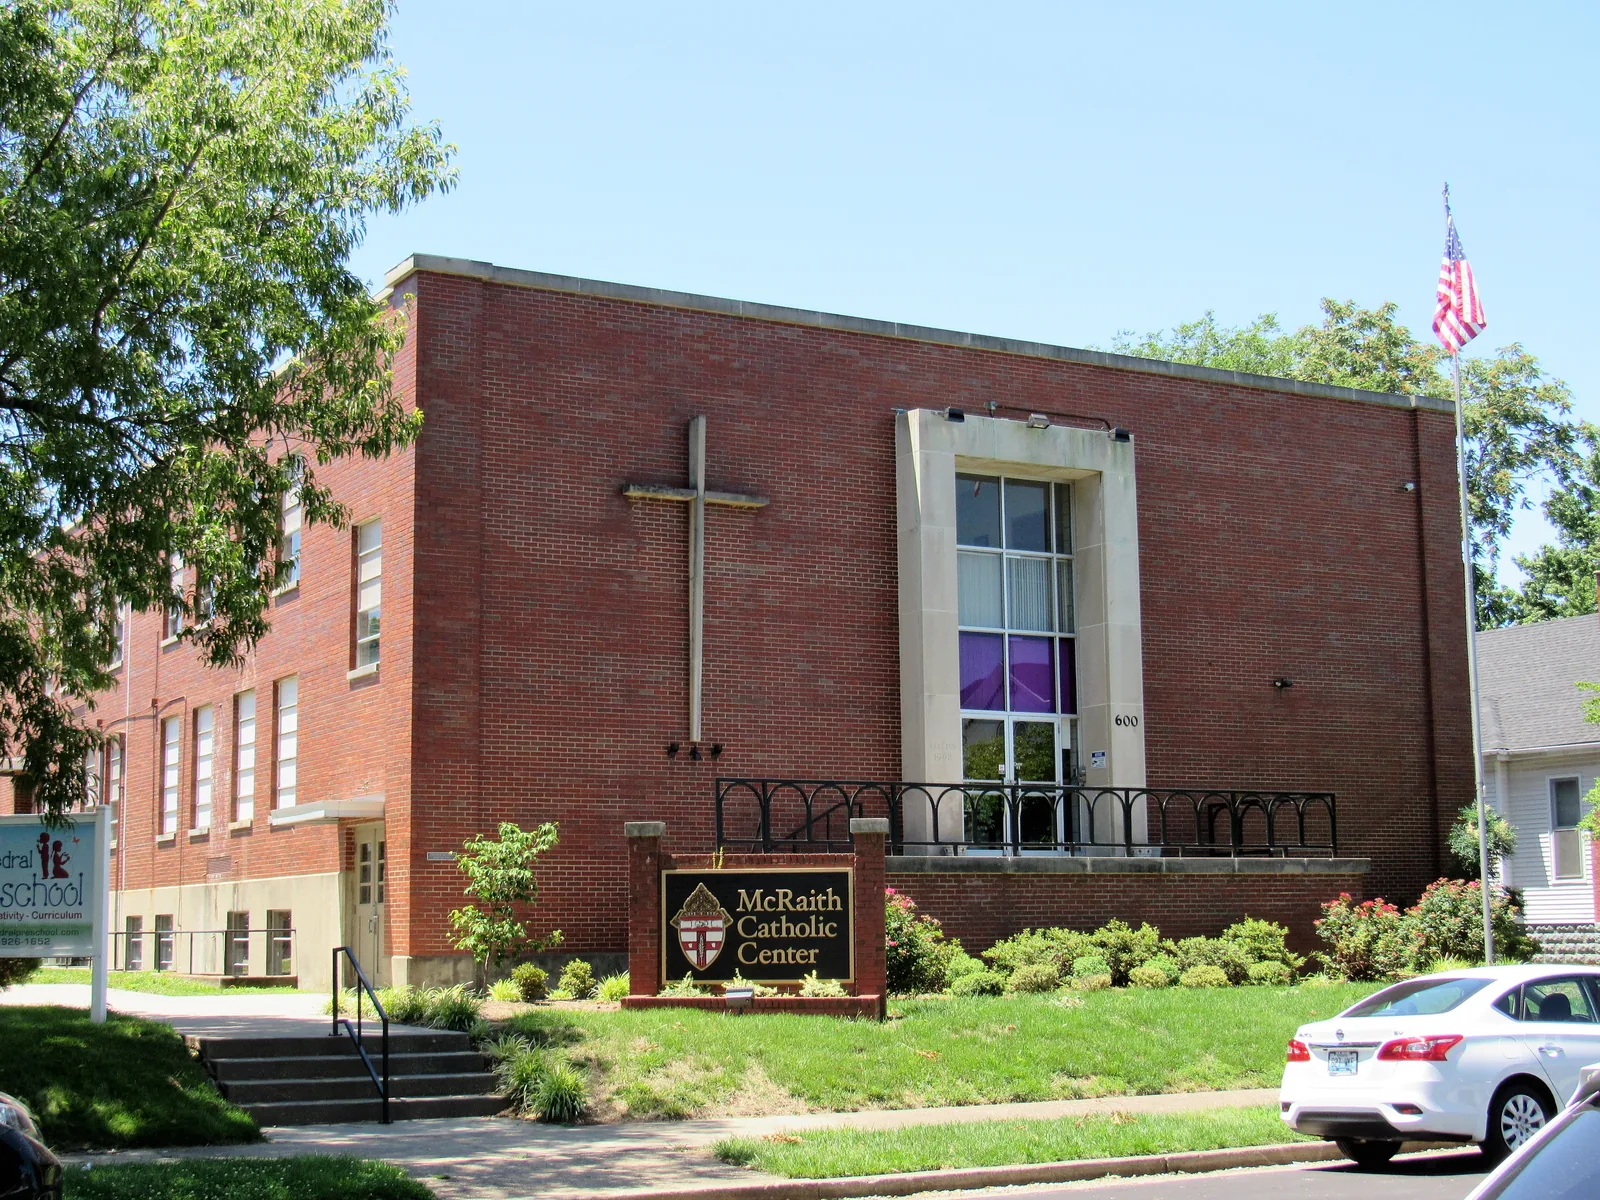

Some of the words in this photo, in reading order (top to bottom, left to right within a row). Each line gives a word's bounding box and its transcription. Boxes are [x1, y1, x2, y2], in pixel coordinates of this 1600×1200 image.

[1115, 714, 1138, 727] 600
[0, 850, 33, 868] dral
[0, 872, 83, 907] school
[736, 888, 843, 911] McRaith
[31, 911, 82, 920] Curriculum
[737, 915, 838, 938] Catholic
[737, 941, 820, 964] Center
